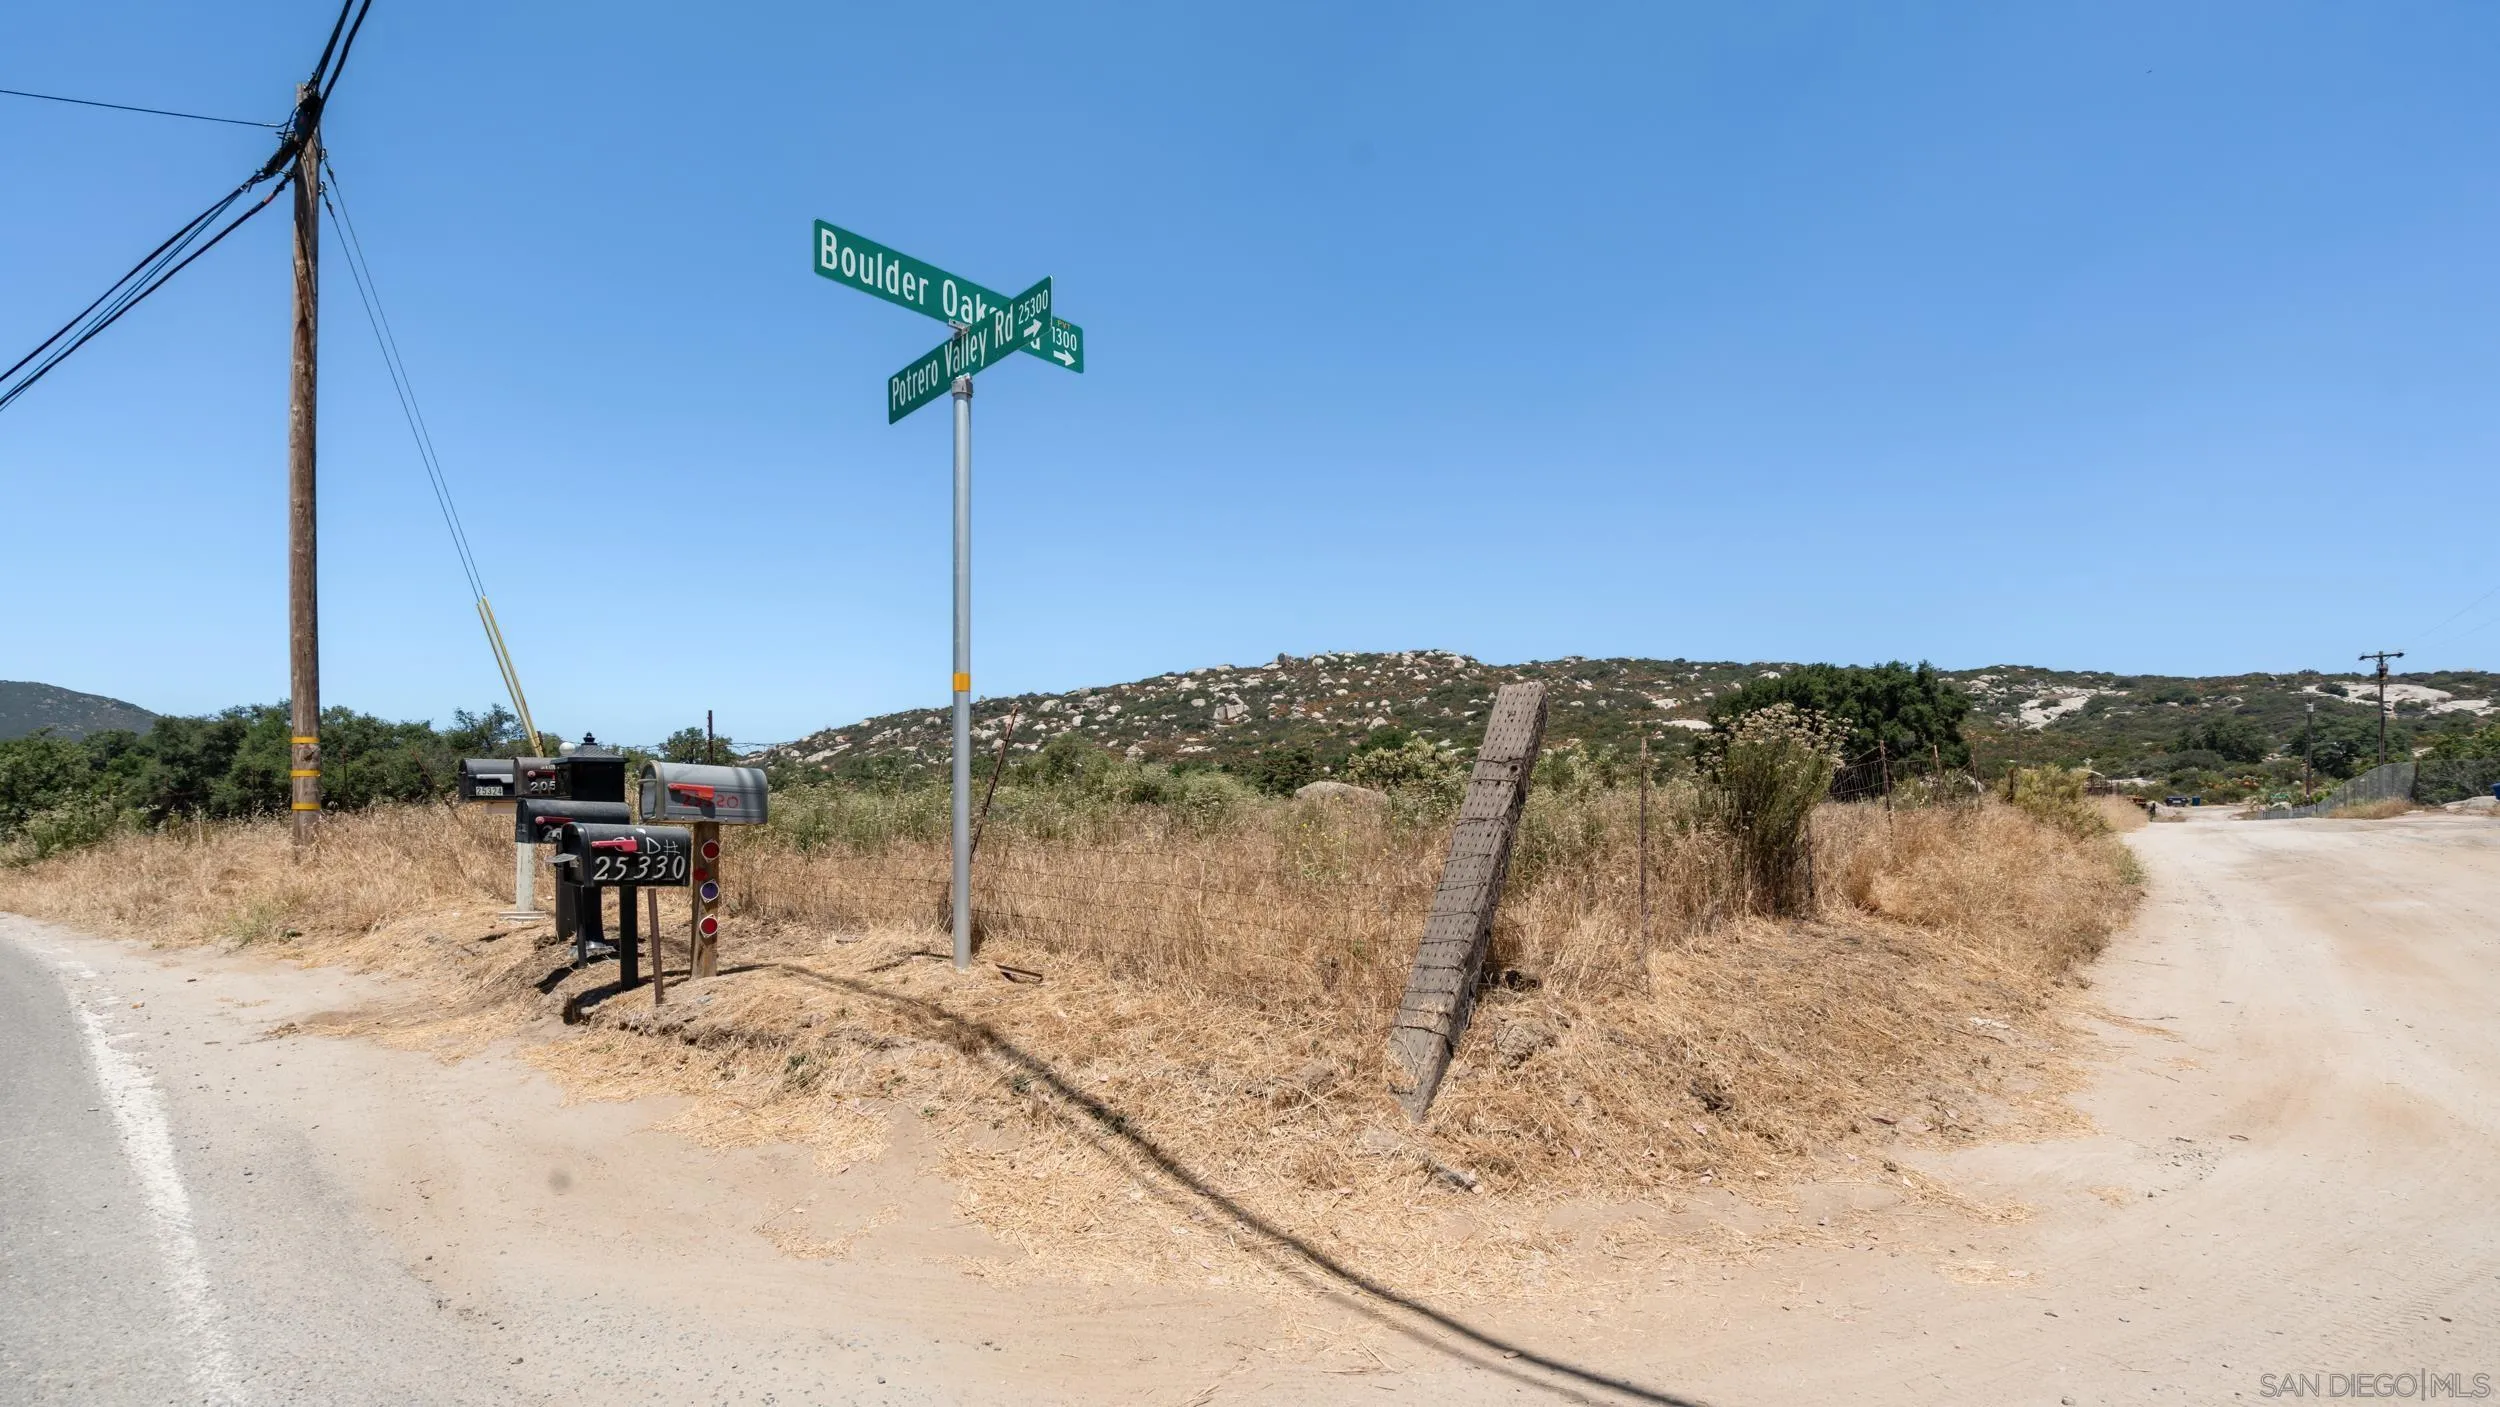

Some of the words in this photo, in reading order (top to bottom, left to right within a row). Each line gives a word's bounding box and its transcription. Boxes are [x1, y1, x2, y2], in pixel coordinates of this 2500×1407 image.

[821, 228, 929, 305] Boulder
[1018, 288, 1048, 325] 25300
[892, 359, 938, 411] Potrero
[944, 327, 987, 378] Valley
[995, 303, 1014, 348] Rd
[1052, 326, 1077, 351] 1300
[593, 855, 686, 881] 25330
